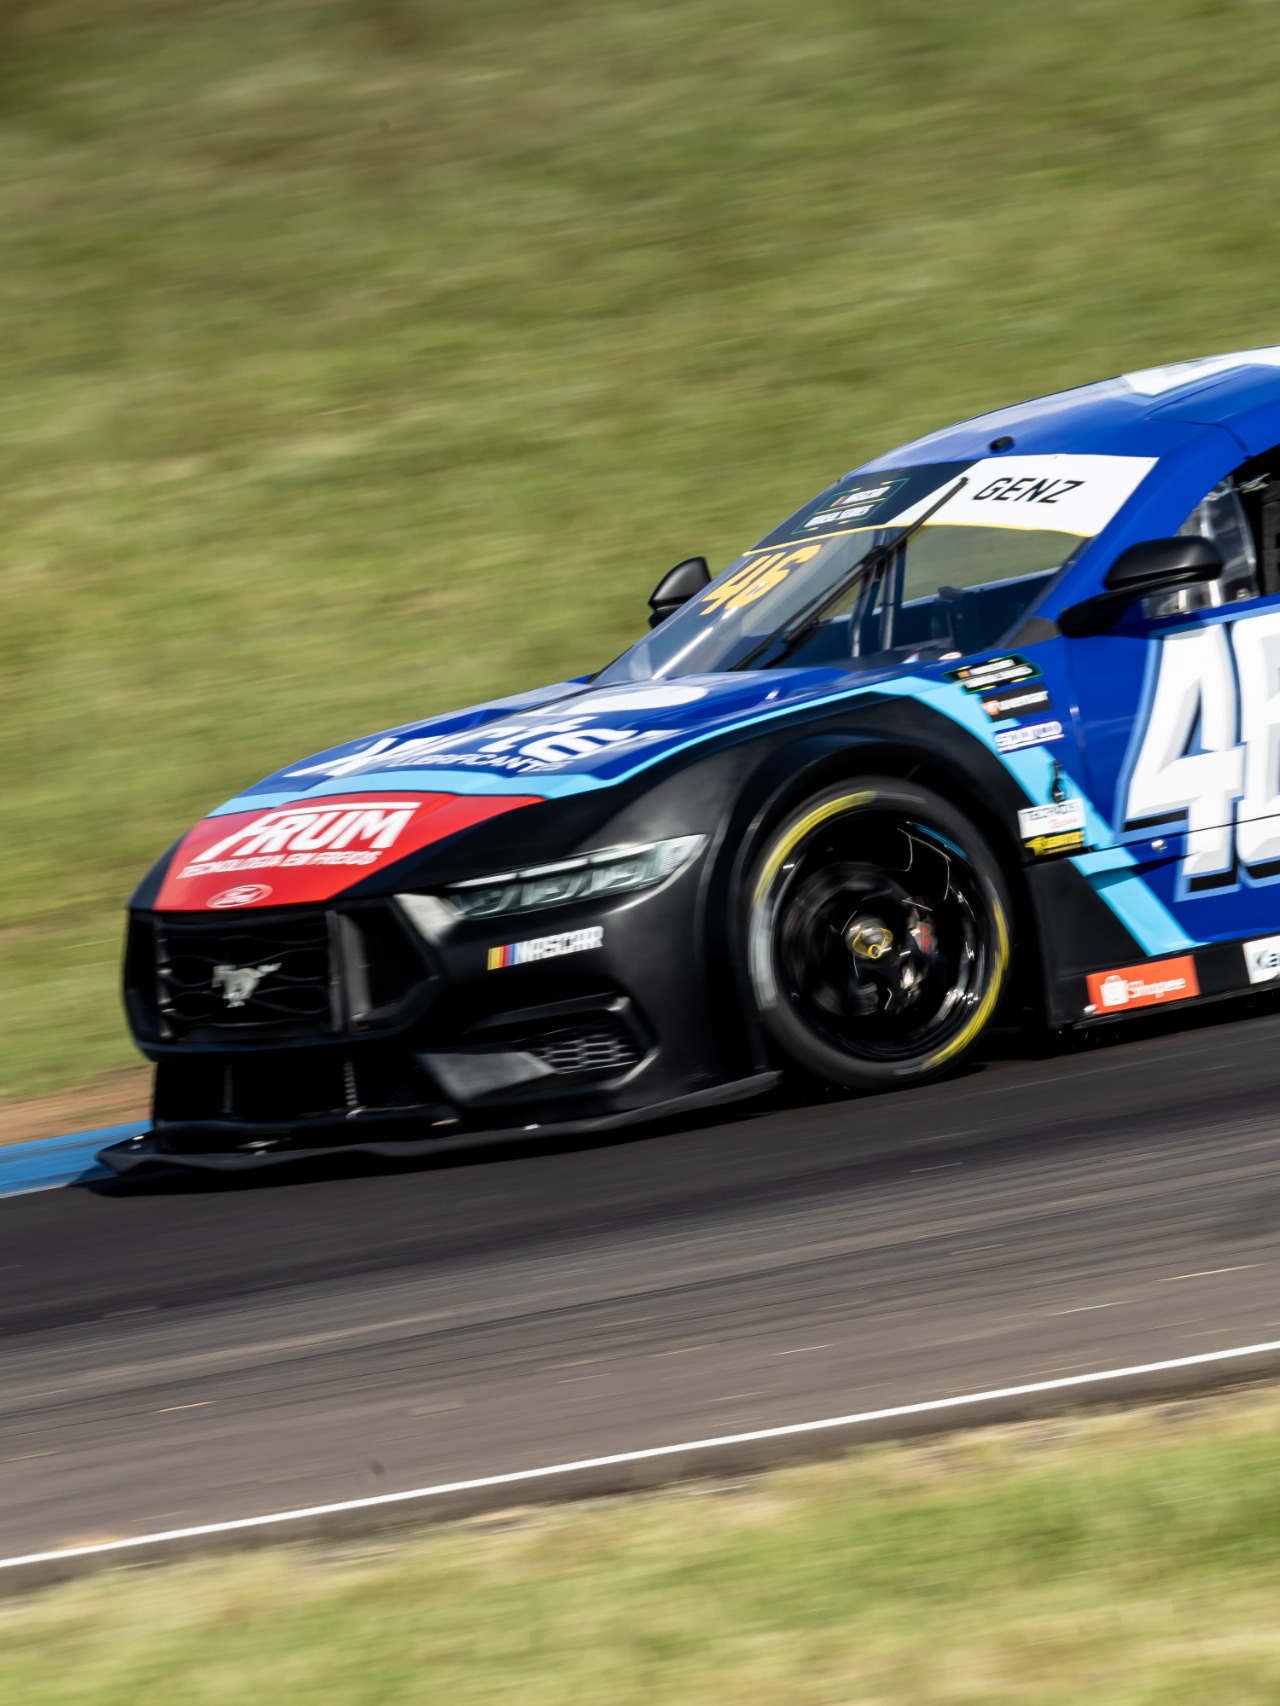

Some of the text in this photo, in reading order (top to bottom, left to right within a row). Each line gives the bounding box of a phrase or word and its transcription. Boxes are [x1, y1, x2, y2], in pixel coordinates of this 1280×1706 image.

[972, 477, 1087, 503] GENZ
[698, 544, 822, 615] 46
[190, 802, 422, 863] FRUM
[175, 855, 281, 879] TECNOLOGIA
